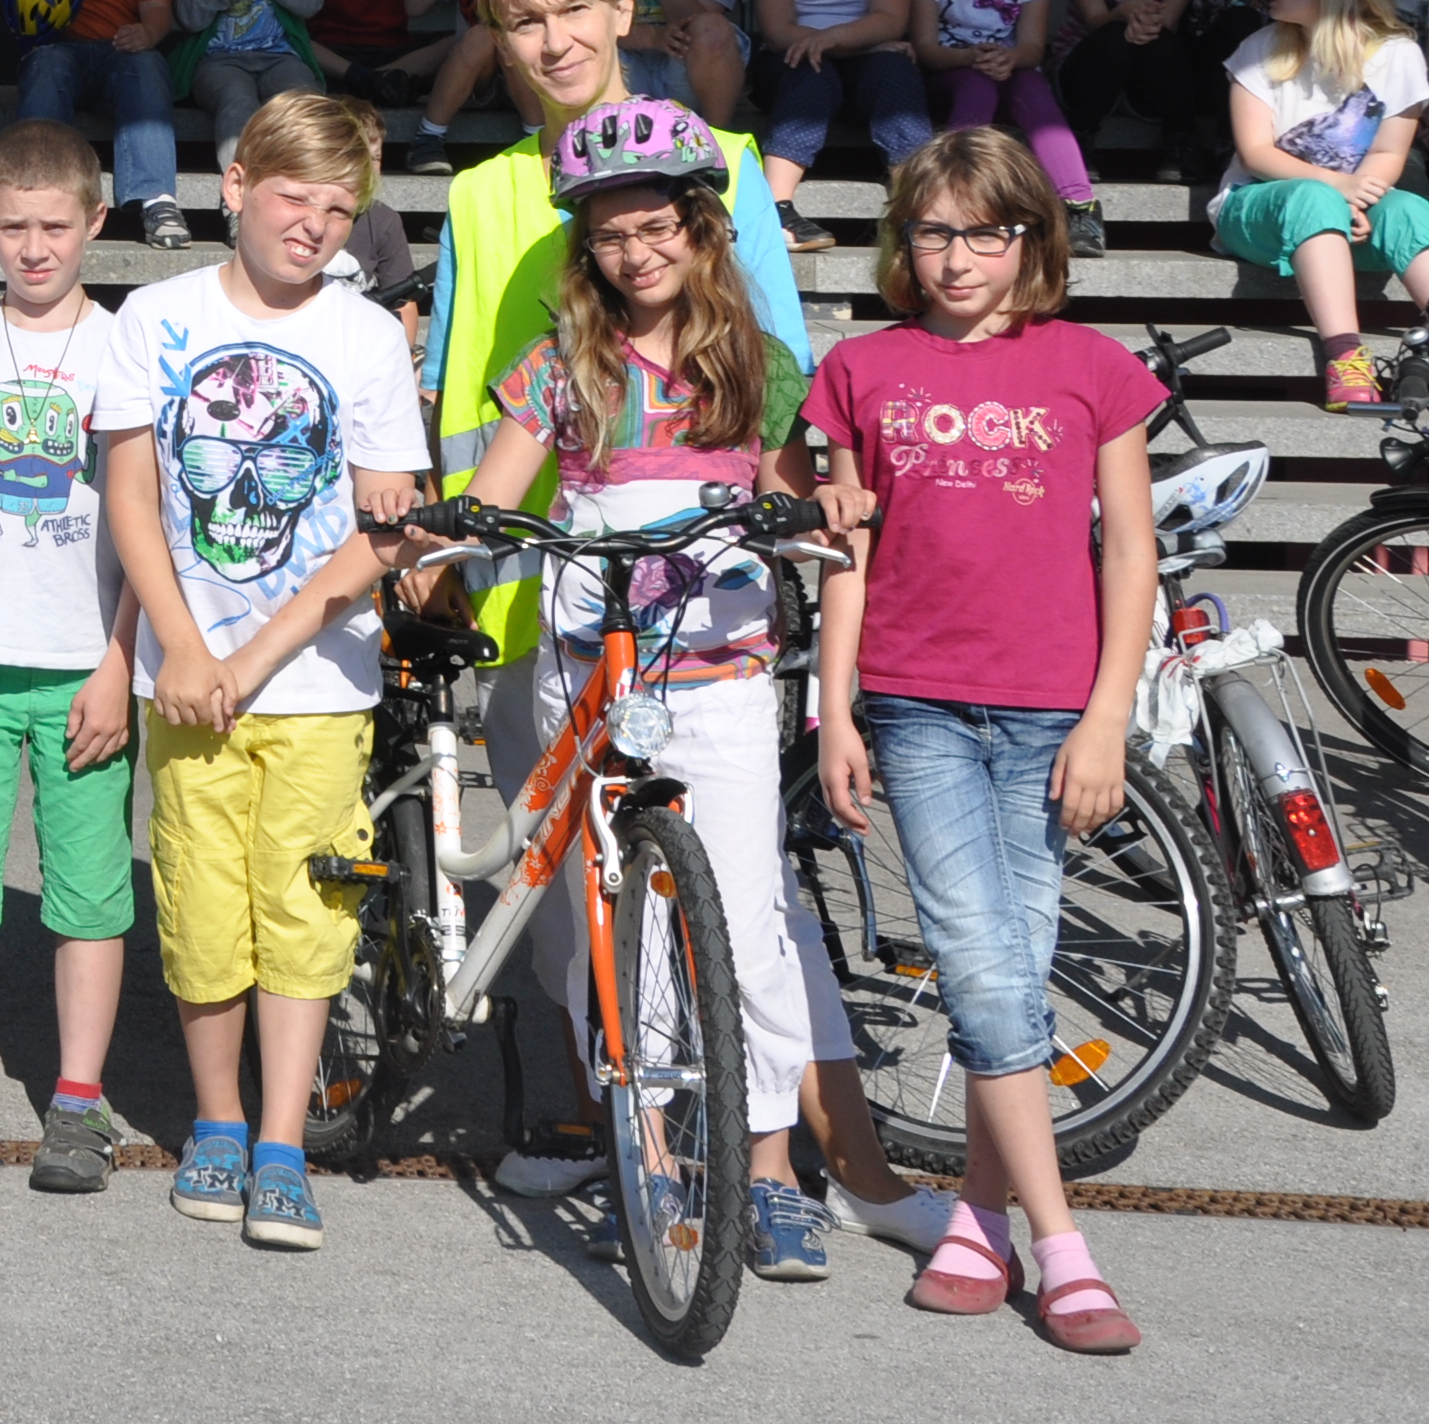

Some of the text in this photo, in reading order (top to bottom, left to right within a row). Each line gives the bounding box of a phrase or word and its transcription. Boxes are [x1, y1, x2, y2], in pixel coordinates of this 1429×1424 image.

[880, 400, 1056, 453] ROCK
[890, 442, 1023, 478] Princess
[935, 478, 977, 489] New Delhi
[1003, 481, 1025, 493] Hard
[1024, 483, 1046, 498] Rock
[40, 513, 92, 533] ATHLETIC
[52, 527, 91, 548] BROSS
